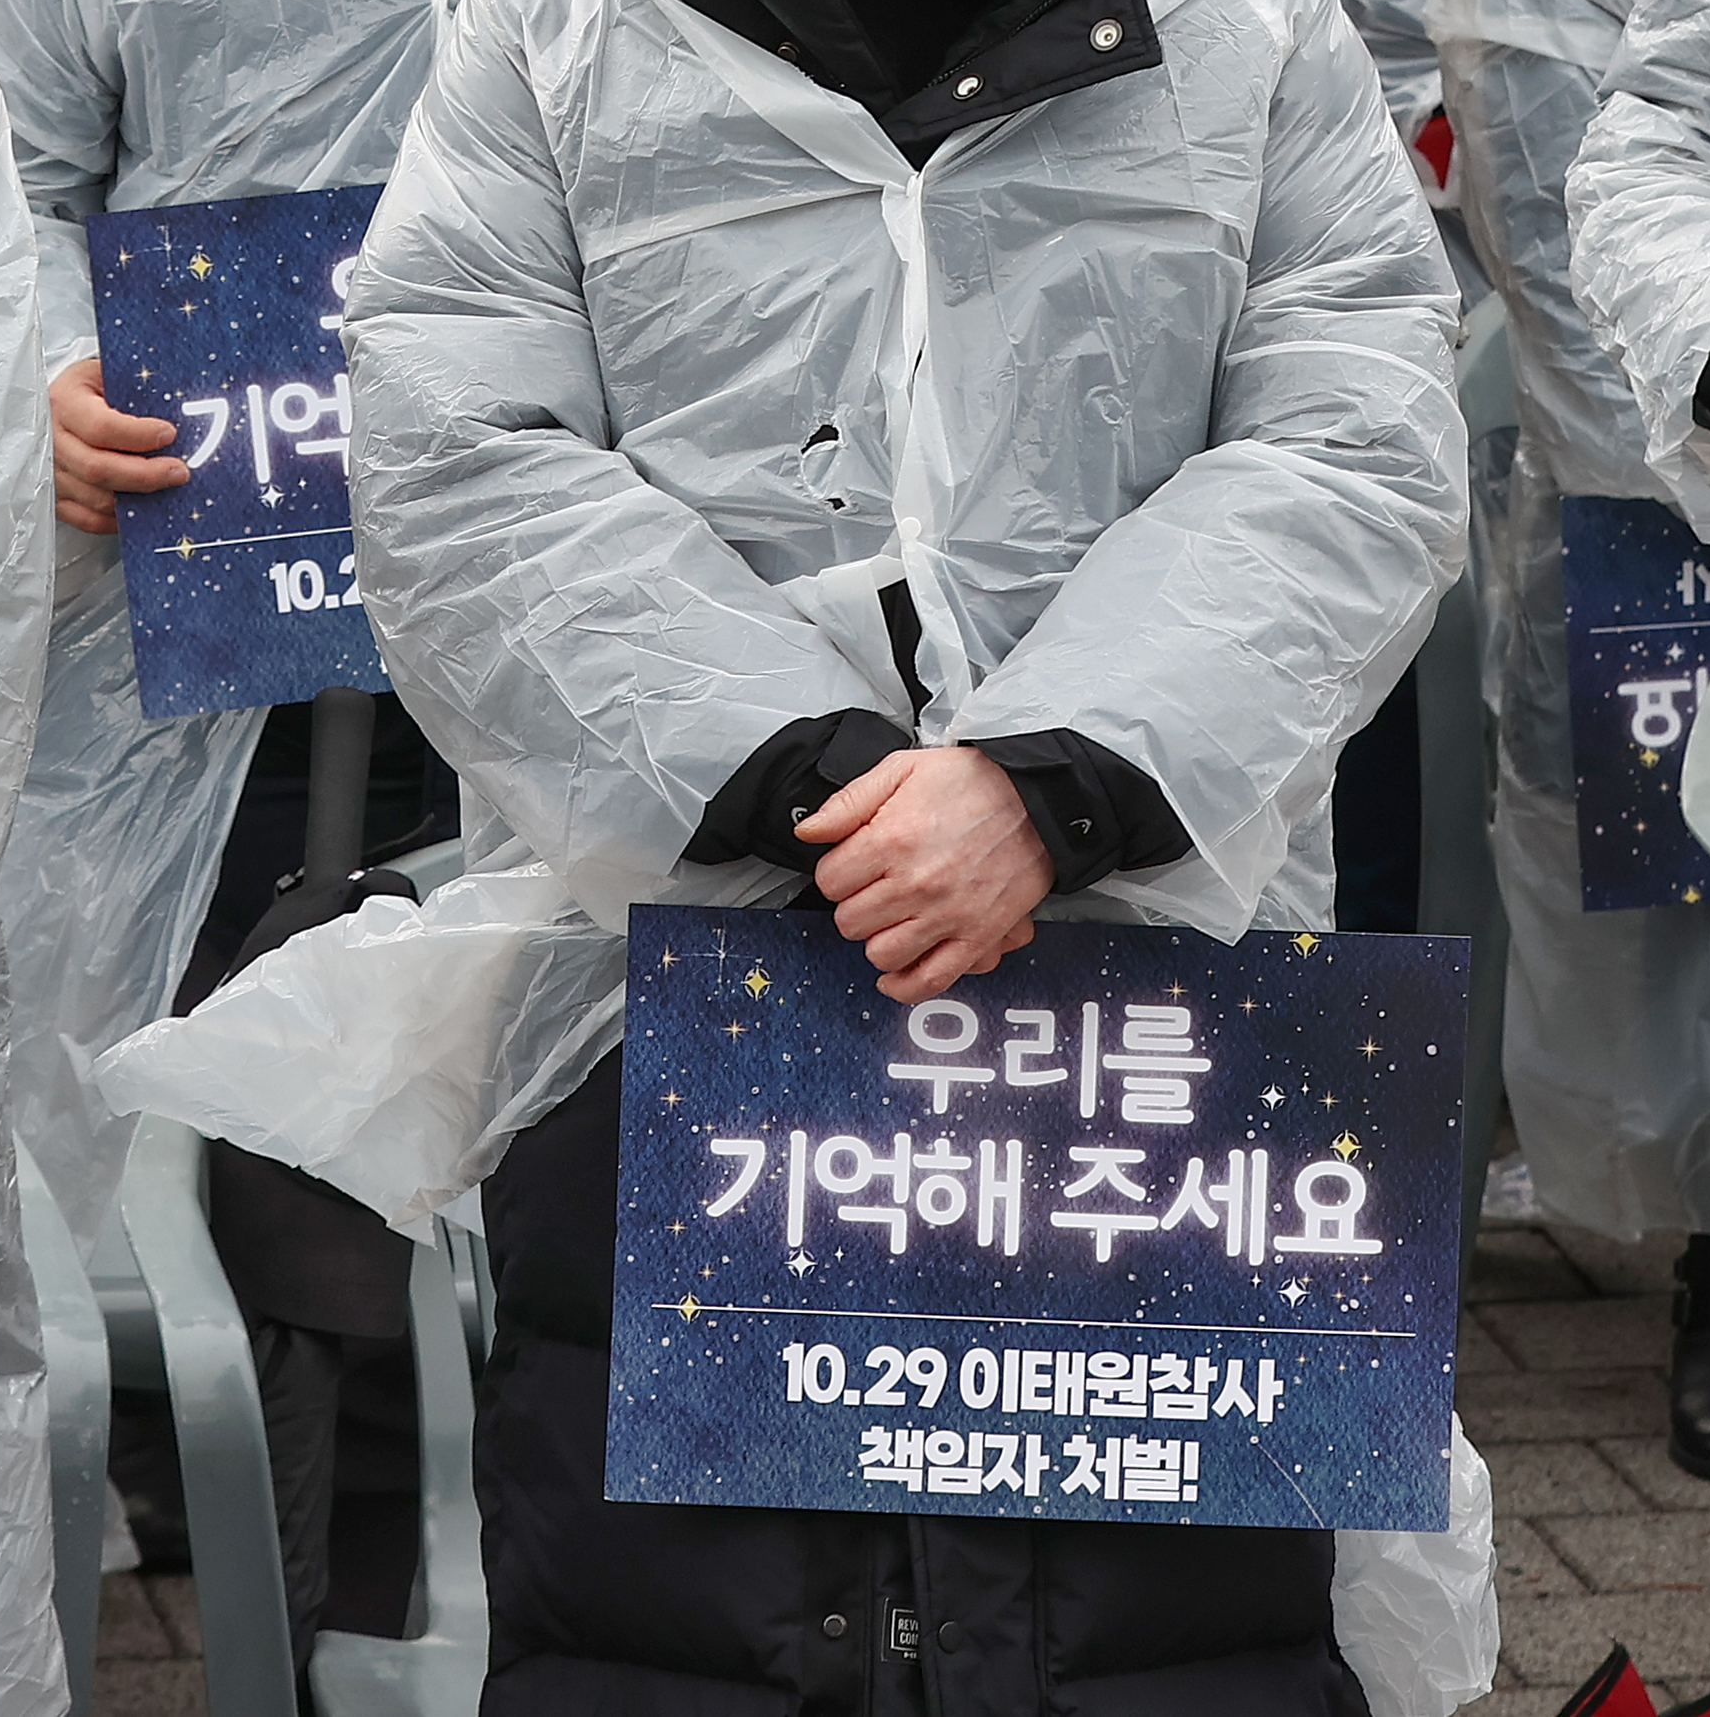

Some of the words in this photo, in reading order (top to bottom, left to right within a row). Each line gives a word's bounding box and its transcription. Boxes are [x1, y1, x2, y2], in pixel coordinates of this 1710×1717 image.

[182, 372, 352, 484] 기억
[887, 998, 1212, 1124] 우리를
[705, 1129, 1023, 1257] 기억해
[1050, 1144, 1385, 1266] 주세요
[782, 1342, 948, 1410] 10.29
[958, 1346, 1285, 1424] 이태원참사
[857, 1425, 1050, 1497] 책임자
[1060, 1433, 1200, 1503] 처벌!
